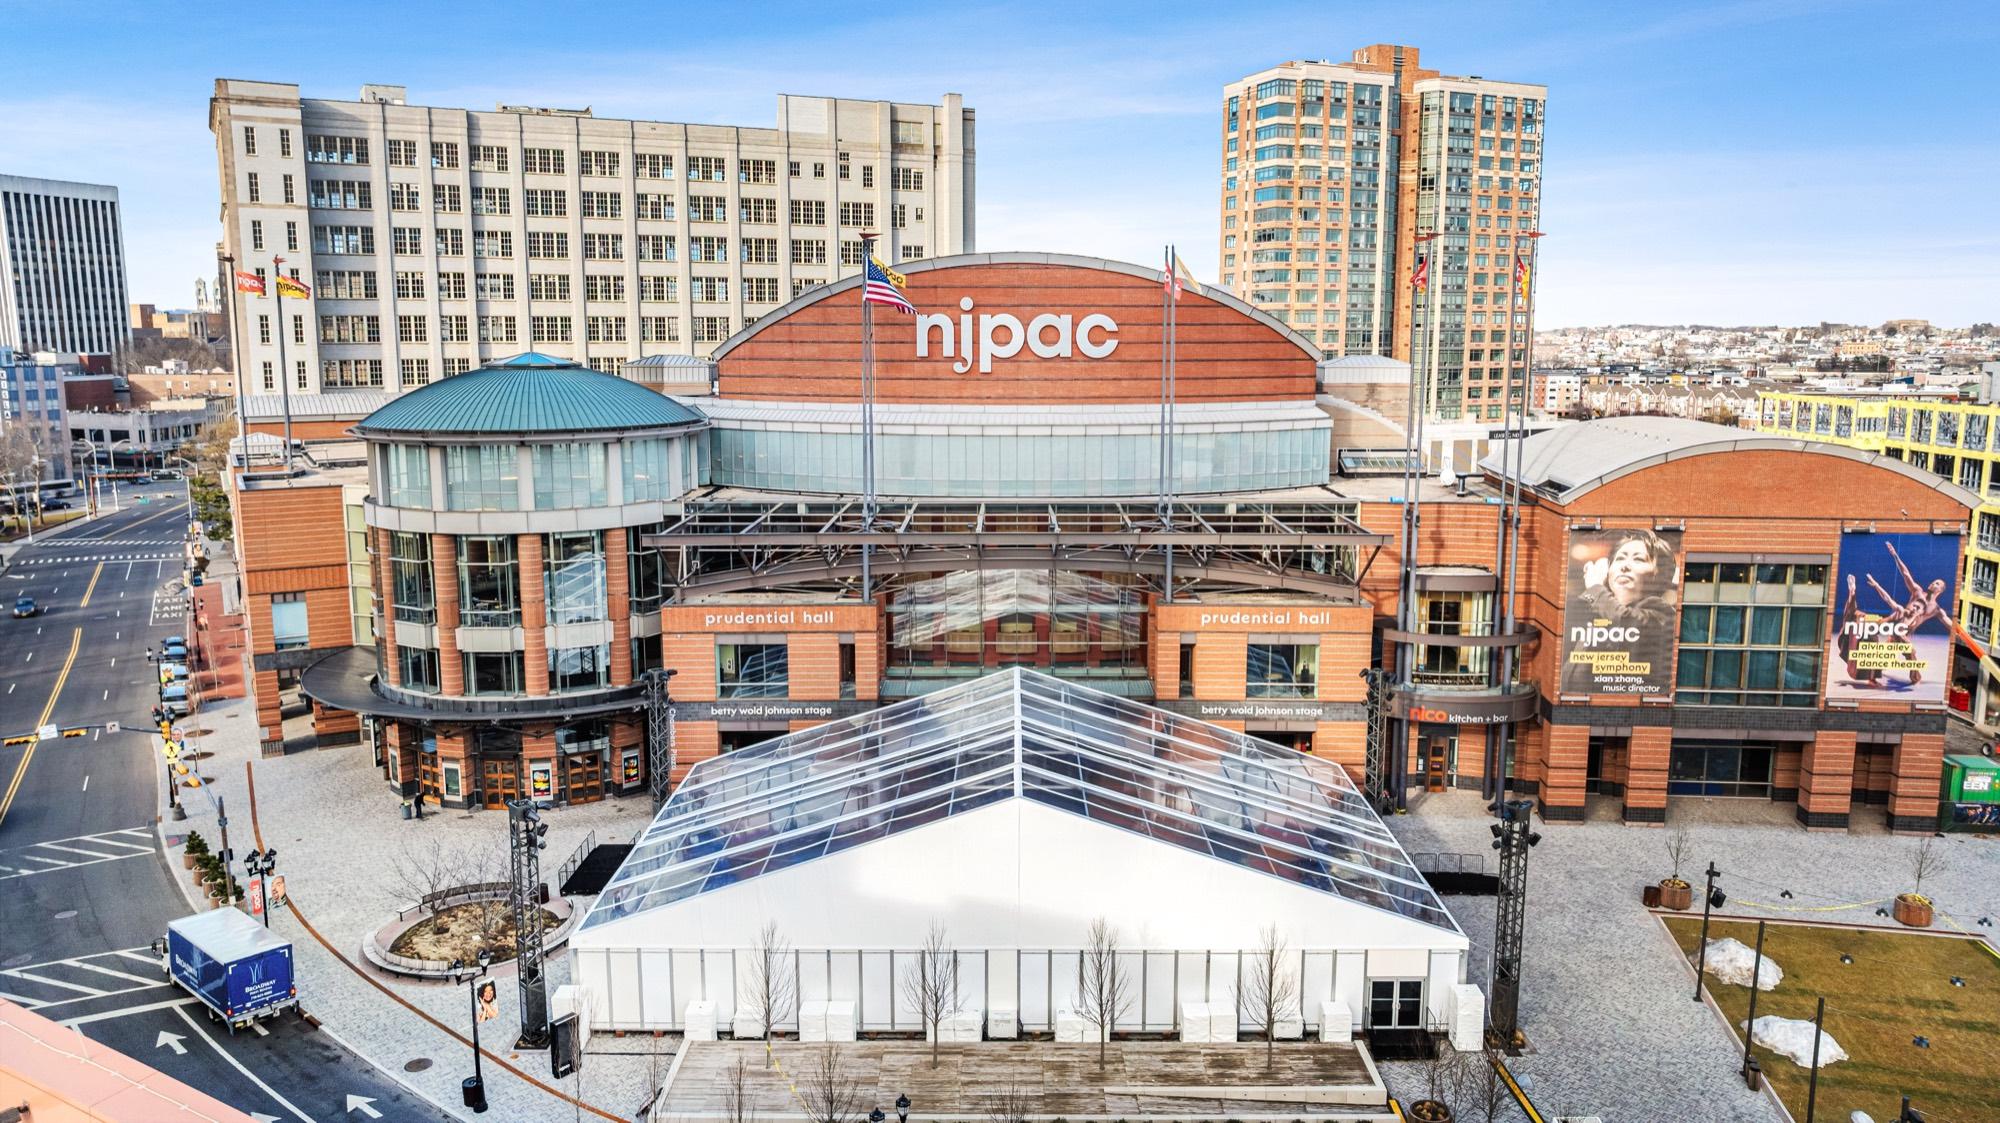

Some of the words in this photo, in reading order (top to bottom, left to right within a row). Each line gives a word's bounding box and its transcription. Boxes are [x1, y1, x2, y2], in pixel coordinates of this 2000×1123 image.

[916, 296, 1119, 374] njpac
[154, 611, 183, 619] TAXI
[705, 611, 794, 627] prudential
[803, 611, 834, 624] hall
[1201, 611, 1290, 627] prudential
[1299, 611, 1331, 624] hall
[1844, 617, 1909, 640] njpac
[1571, 621, 1640, 648] njpac
[1861, 643, 1885, 651] alvin
[1887, 643, 1910, 652] ailey
[1596, 652, 1627, 663] jersey
[1851, 651, 1896, 659] american
[1595, 663, 1648, 674] symphony
[1859, 660, 1889, 668] dance
[1891, 660, 1926, 669] theater
[1594, 675, 1613, 683] xian
[1603, 684, 1626, 692] music
[1628, 684, 1661, 693] director
[711, 705, 737, 717] betty
[739, 705, 763, 715] wold
[764, 705, 803, 717] johnson
[805, 706, 833, 717] stage
[1201, 705, 1228, 717] betty
[1230, 705, 1253, 715] wold
[1255, 705, 1294, 717] johnson
[1295, 706, 1323, 717] stage
[1410, 704, 1448, 722] nico
[1449, 713, 1484, 724] kitchen
[1493, 713, 1509, 722] bar
